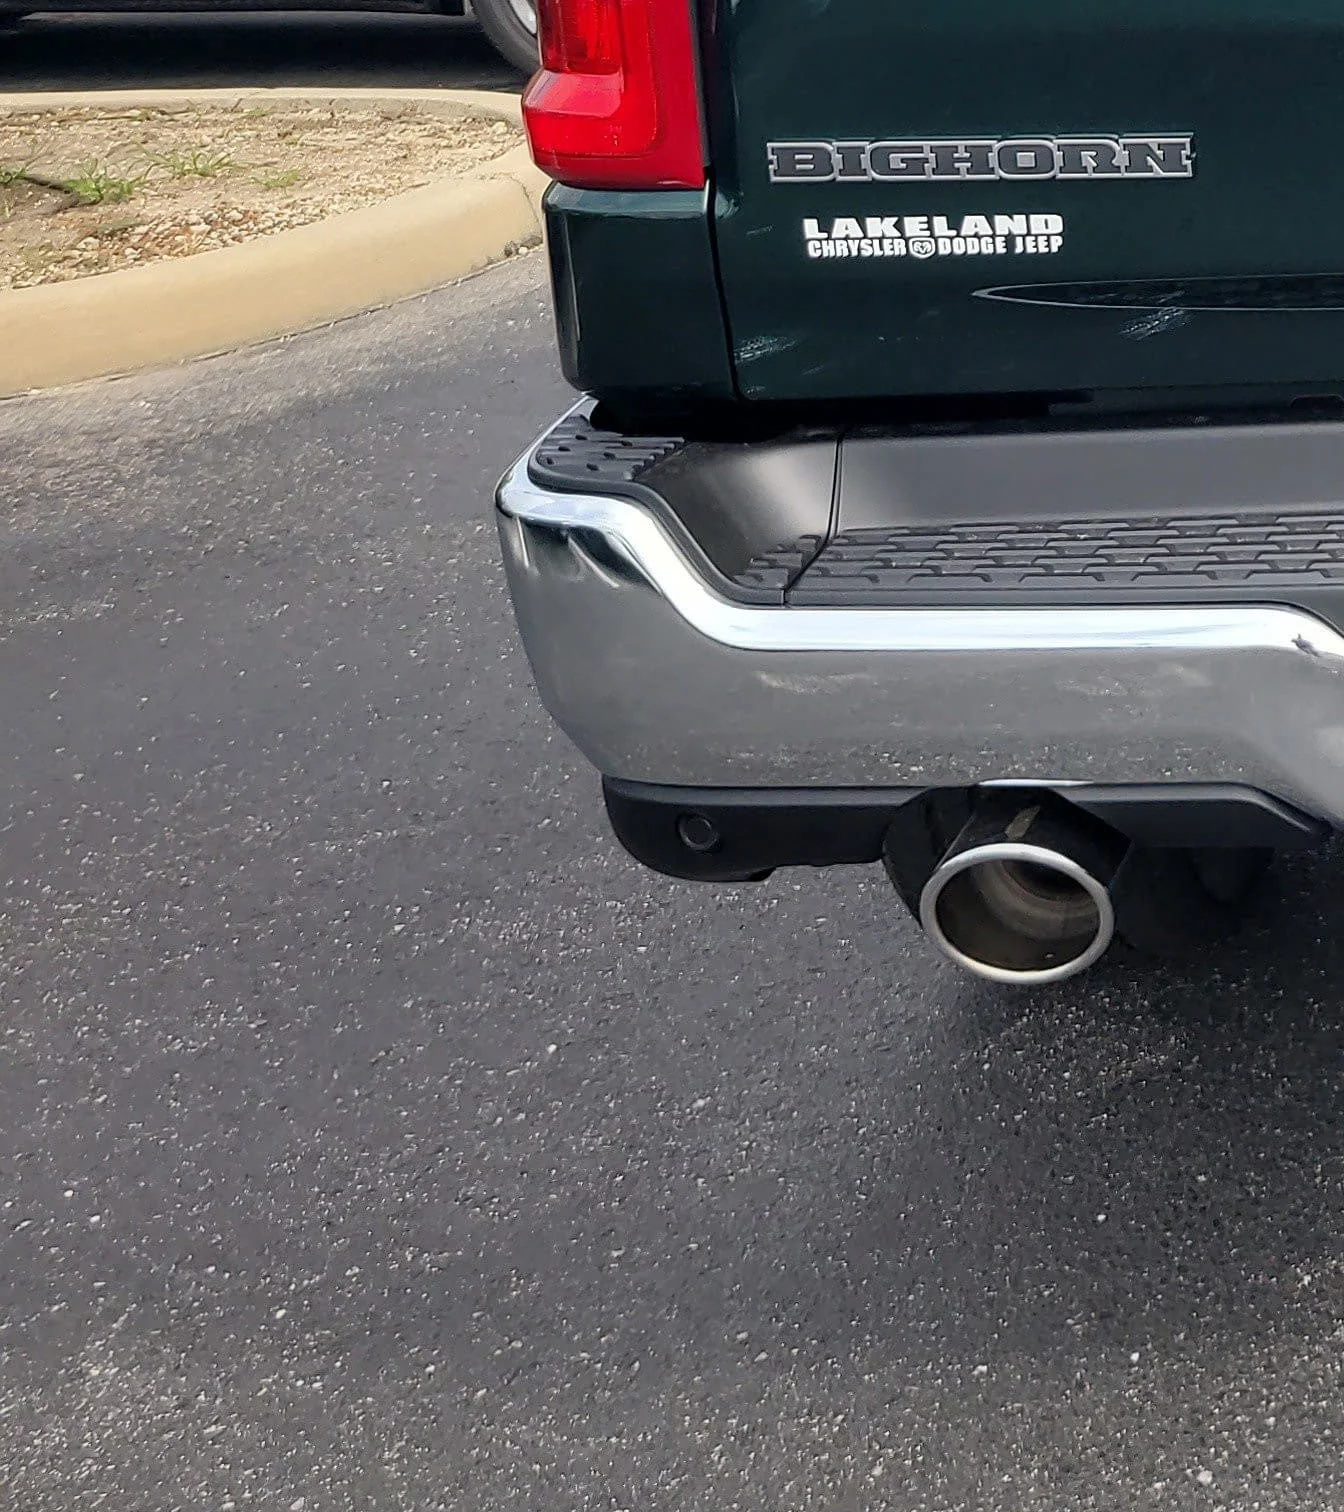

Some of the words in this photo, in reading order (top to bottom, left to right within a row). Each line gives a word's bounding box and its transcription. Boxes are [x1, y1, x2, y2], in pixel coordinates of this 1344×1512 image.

[767, 133, 1195, 183] BIGHORN
[802, 214, 1064, 239] LAKELAND
[807, 238, 907, 258] CHRYSLER
[938, 236, 1008, 256] DODGE
[1014, 235, 1064, 255] JEEP
